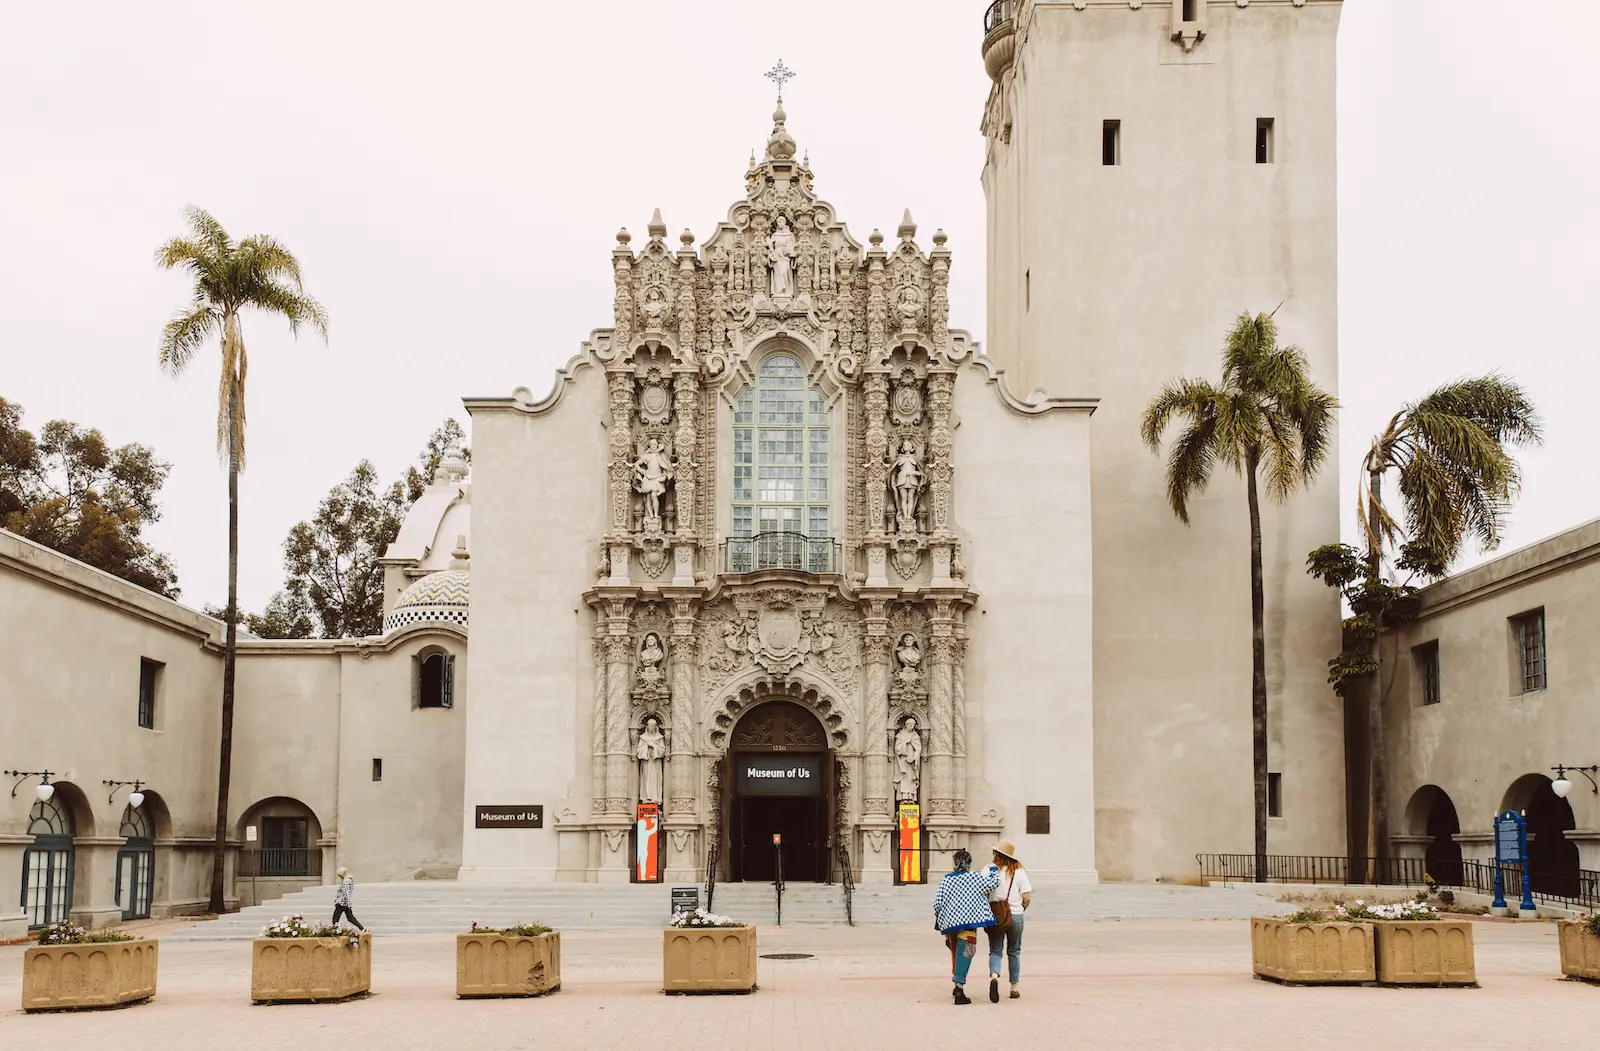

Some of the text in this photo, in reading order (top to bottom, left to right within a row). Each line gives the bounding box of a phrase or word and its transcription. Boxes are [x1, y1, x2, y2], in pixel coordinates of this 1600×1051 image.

[748, 768, 810, 778] Museum of Us
[481, 812, 538, 820] Museum of Us
